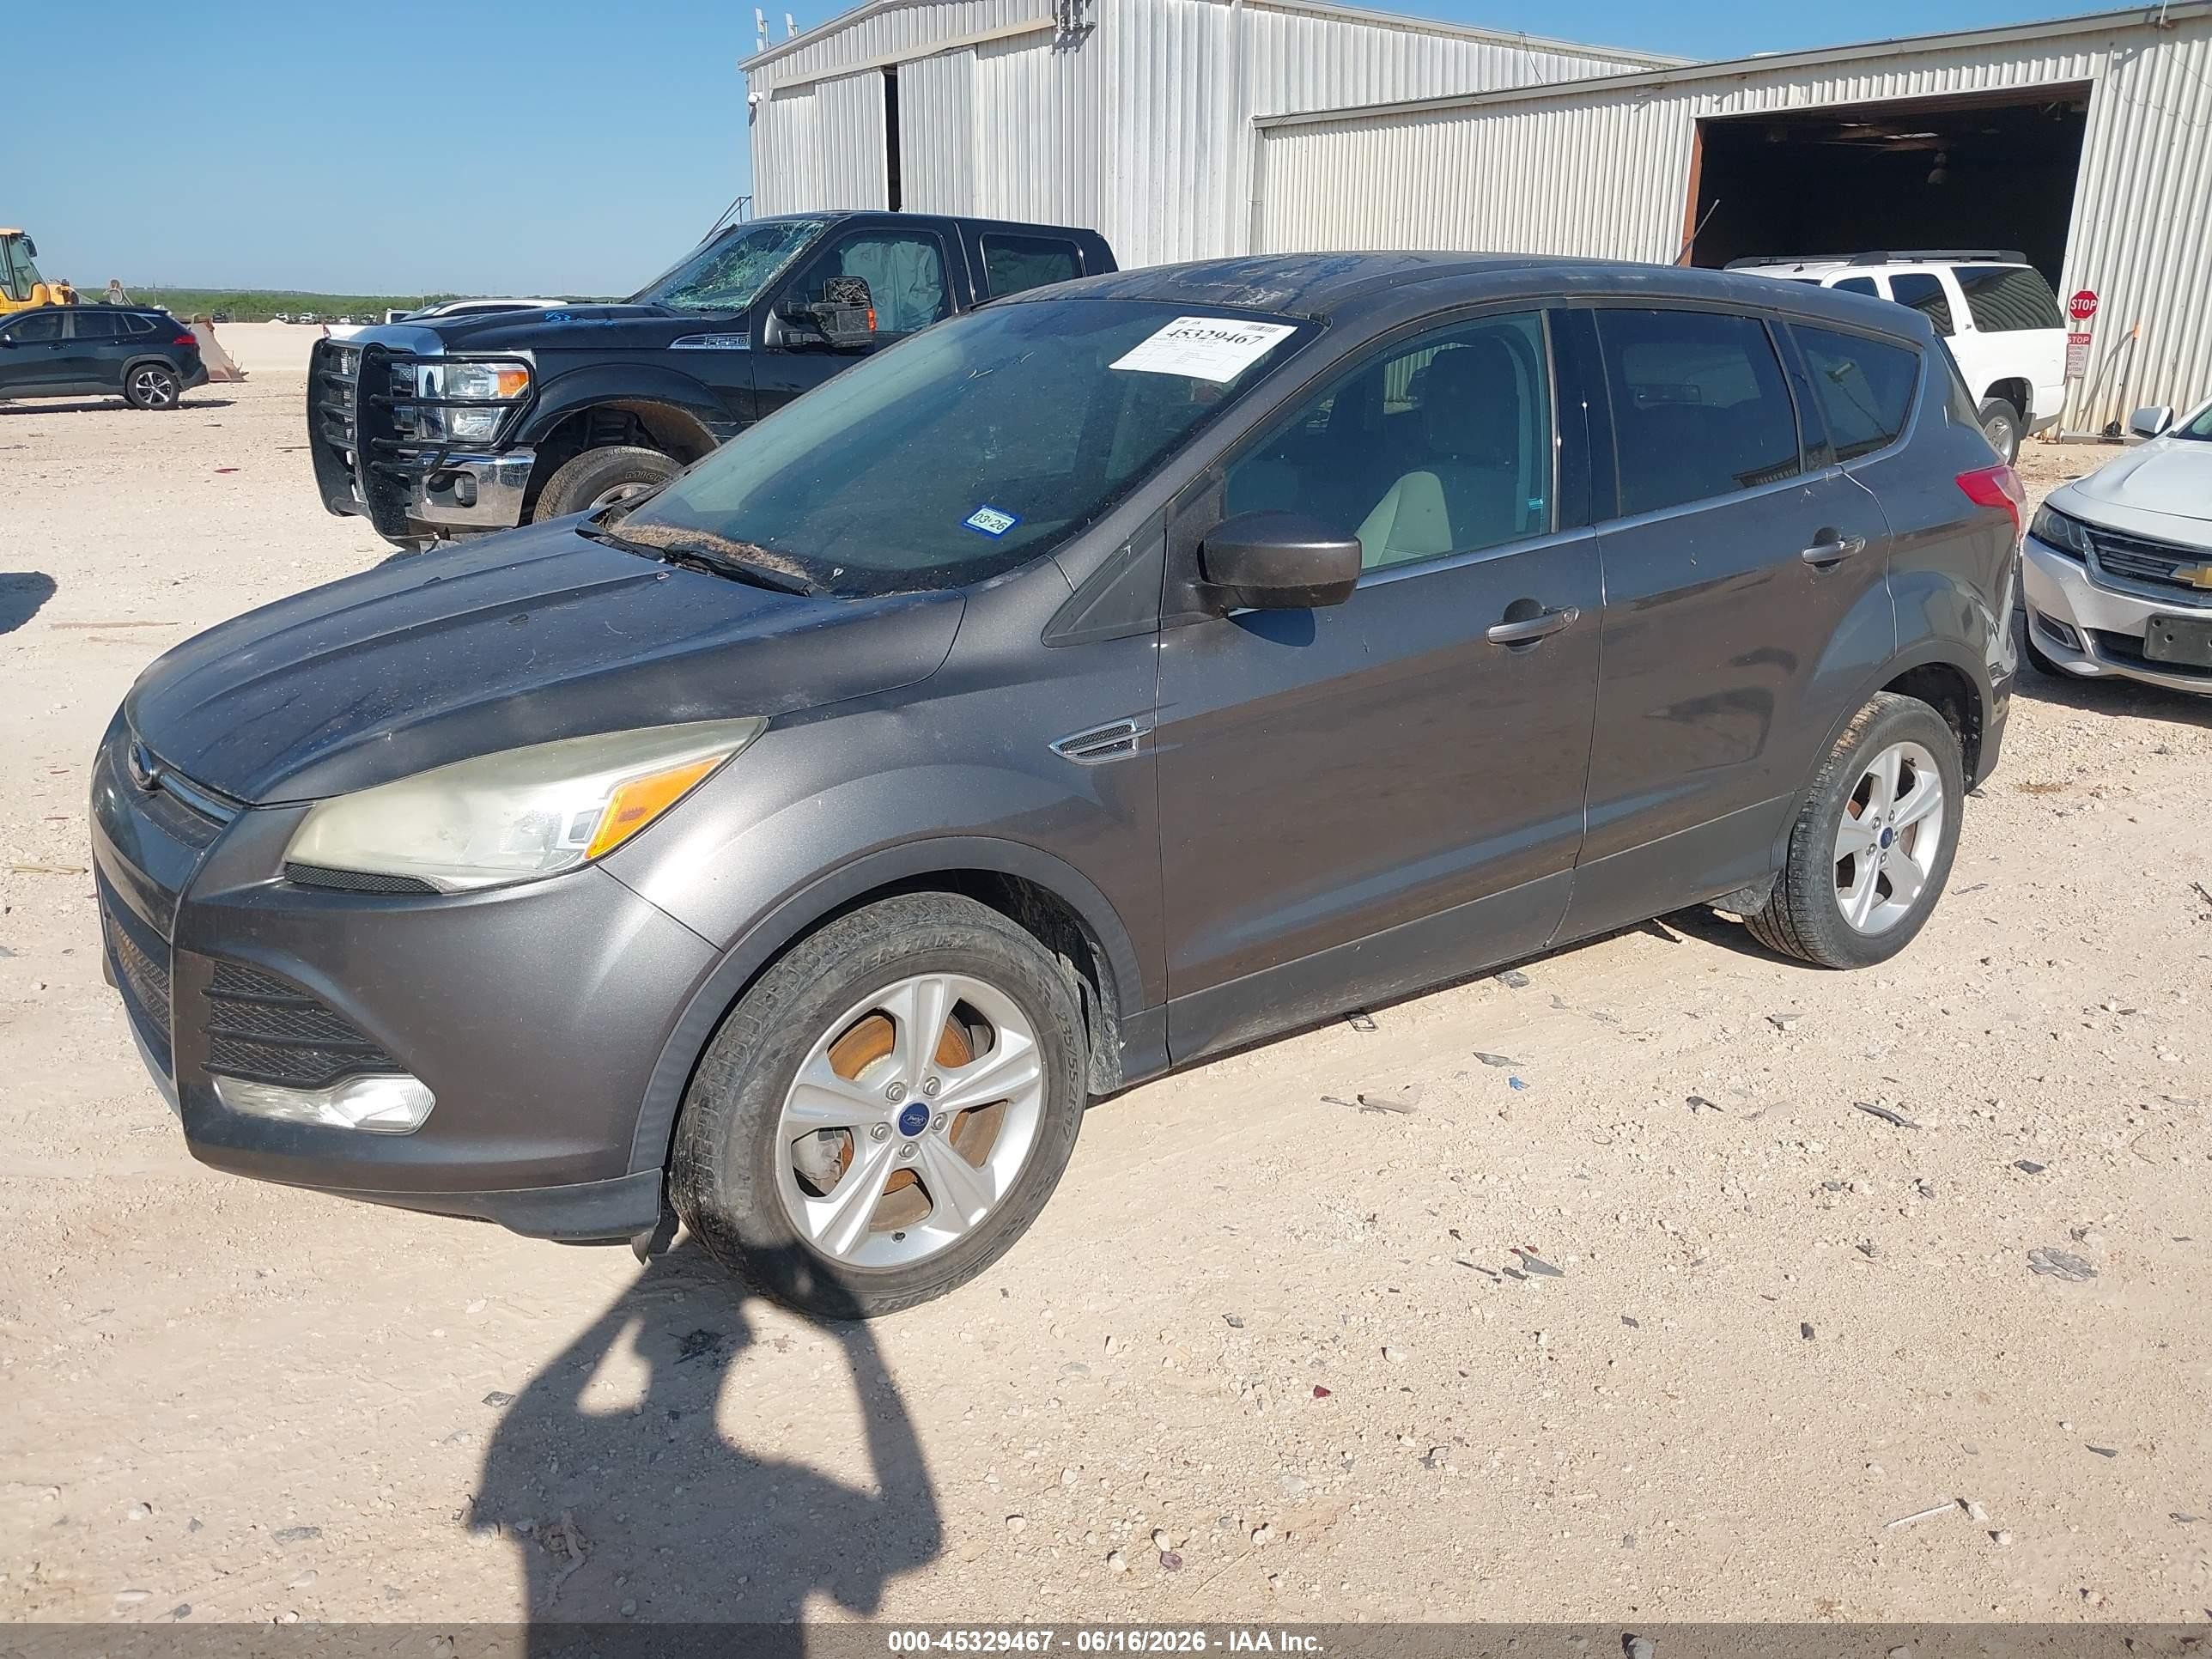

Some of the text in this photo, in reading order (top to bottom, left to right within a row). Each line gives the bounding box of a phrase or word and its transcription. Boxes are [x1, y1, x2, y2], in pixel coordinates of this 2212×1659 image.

[2070, 299, 2097, 311] STOP
[1167, 328, 1266, 345] 45329467
[973, 514, 1008, 531] 03 26
